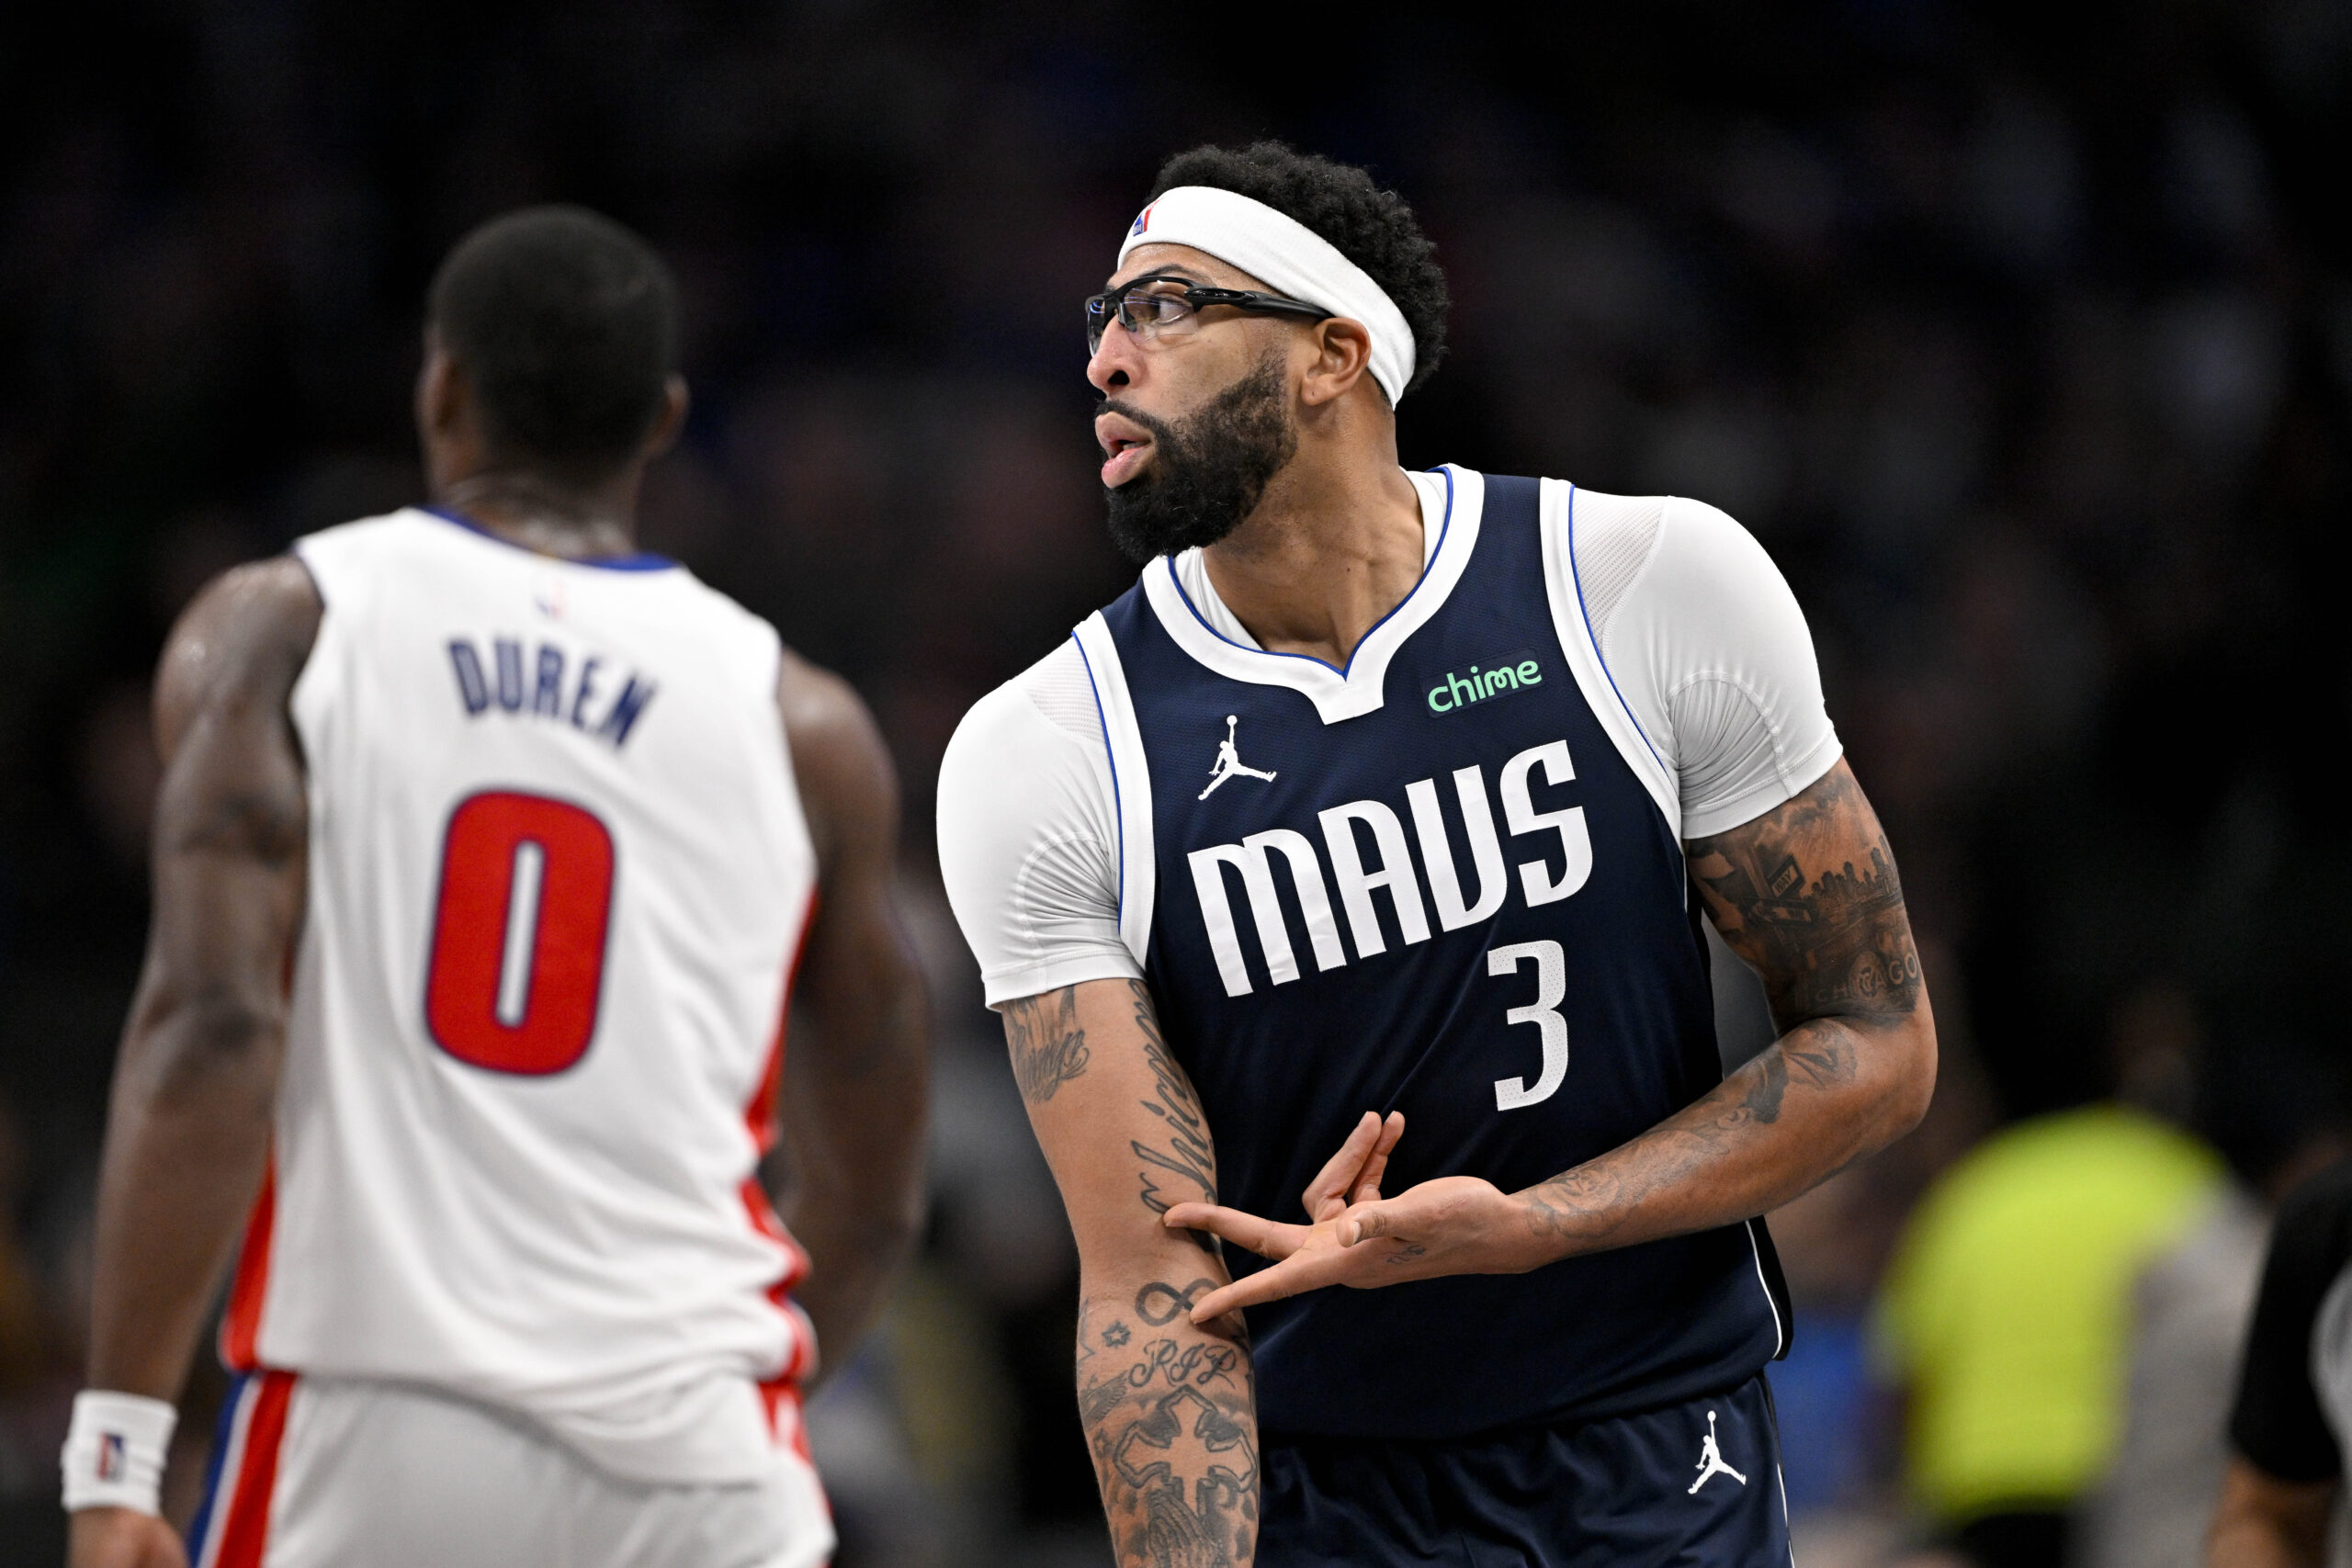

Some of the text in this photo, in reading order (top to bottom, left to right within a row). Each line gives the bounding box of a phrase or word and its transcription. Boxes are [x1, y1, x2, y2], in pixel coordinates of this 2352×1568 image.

[447, 638, 656, 747] DUREN
[1428, 660, 1542, 712] chime
[423, 786, 617, 1078] 0
[1187, 739, 1592, 998] MAVS
[1487, 940, 1568, 1111] 3
[1128, 1338, 1236, 1389] RIP
